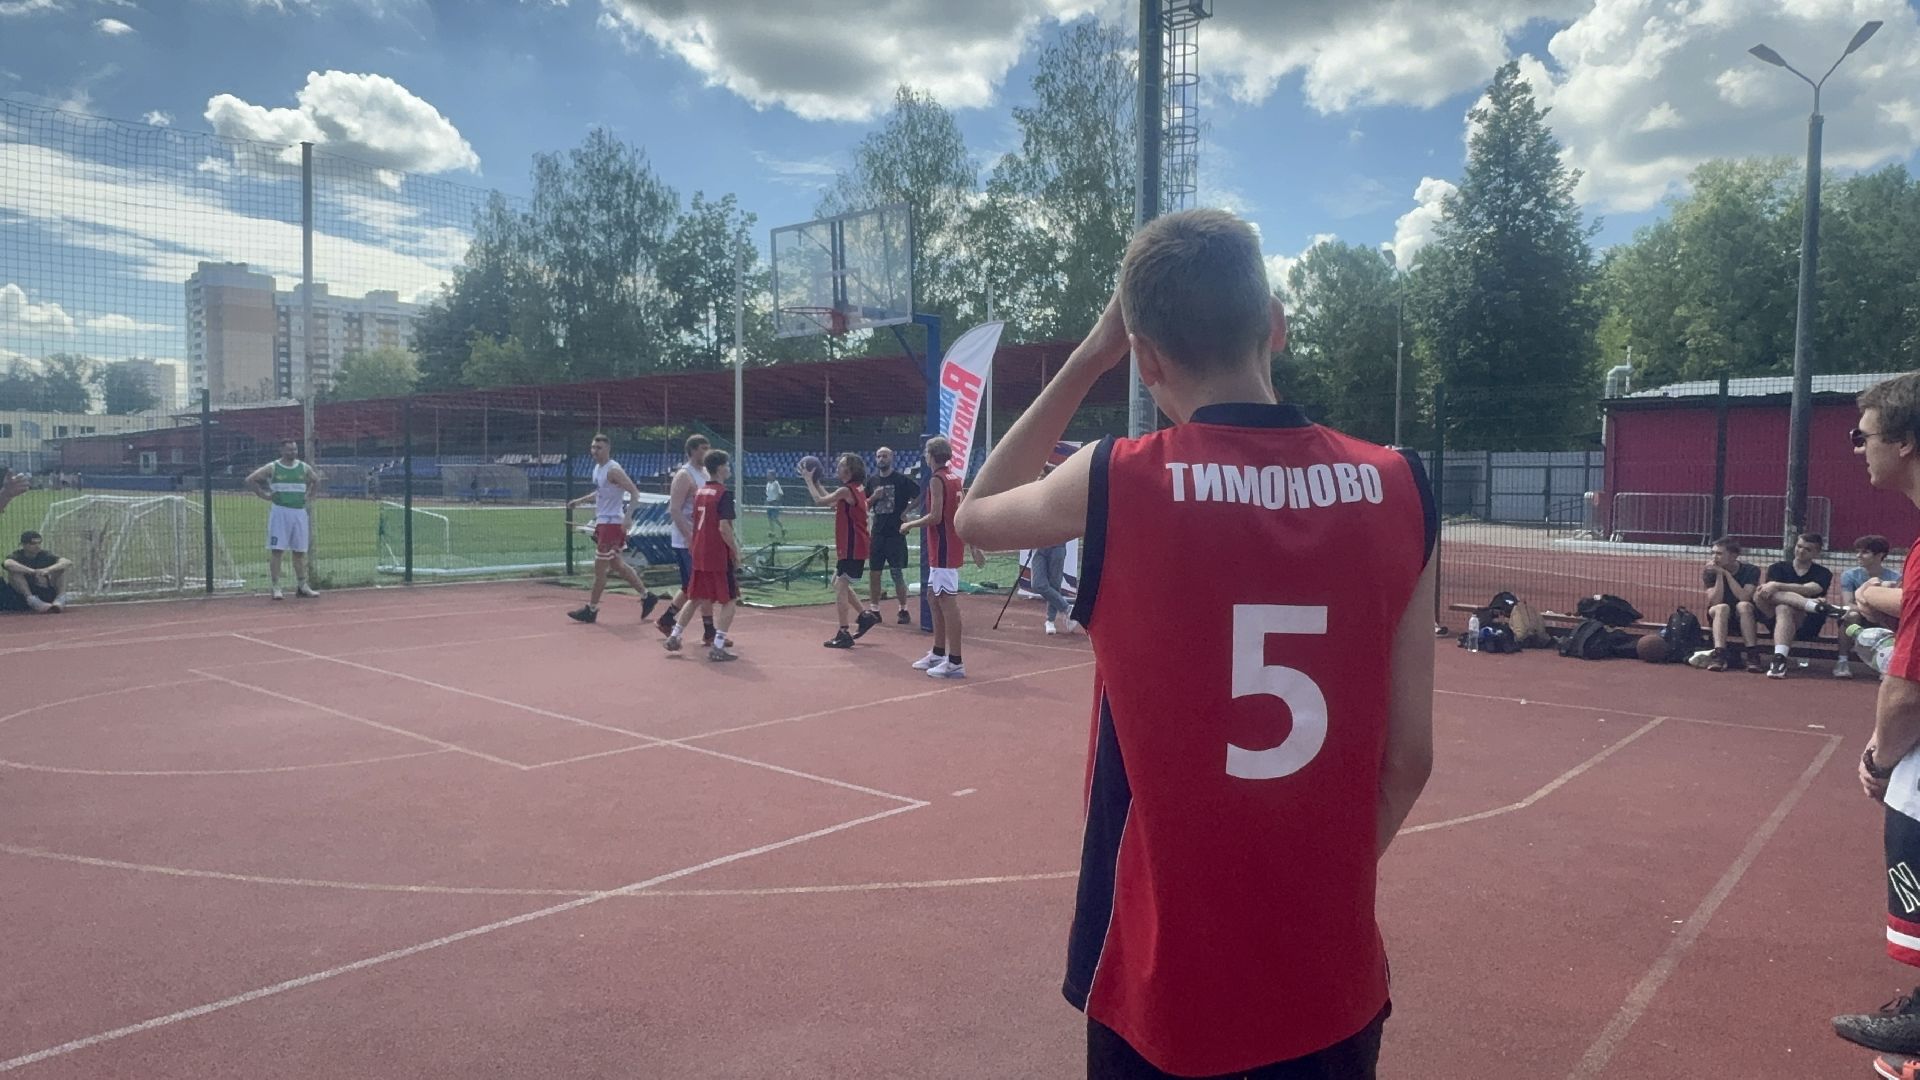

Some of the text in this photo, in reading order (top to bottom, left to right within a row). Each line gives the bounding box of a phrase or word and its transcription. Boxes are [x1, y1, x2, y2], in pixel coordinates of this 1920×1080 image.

[942, 361, 982, 470] ВАРДИЯ
[697, 506, 705, 530] 7
[1165, 462, 1384, 510] ТИМОНОВО
[1225, 604, 1328, 780] 5
